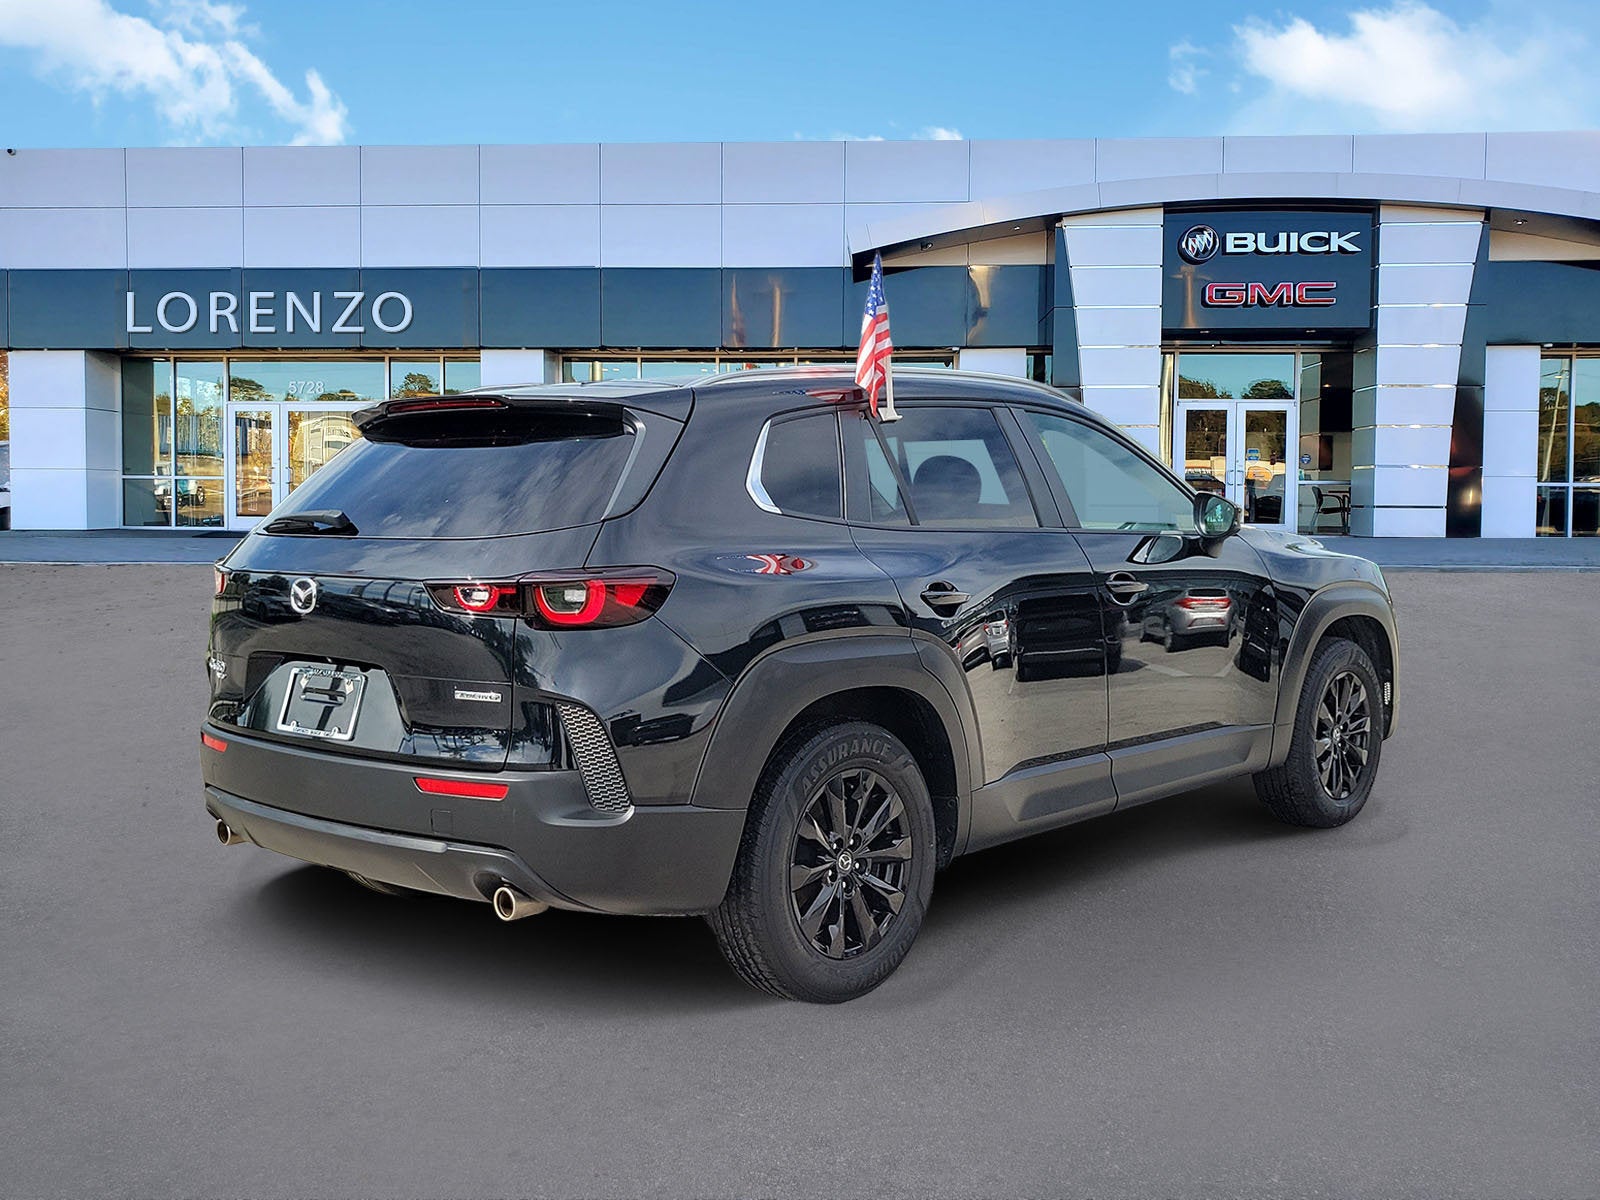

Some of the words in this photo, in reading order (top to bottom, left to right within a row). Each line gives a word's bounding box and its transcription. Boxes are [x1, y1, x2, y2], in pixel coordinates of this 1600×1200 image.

[1225, 231, 1362, 253] BUICK
[1205, 281, 1337, 305] GMC
[126, 291, 414, 334] LORENZO
[288, 381, 325, 394] 5728
[801, 738, 892, 796] ASSURANCE
